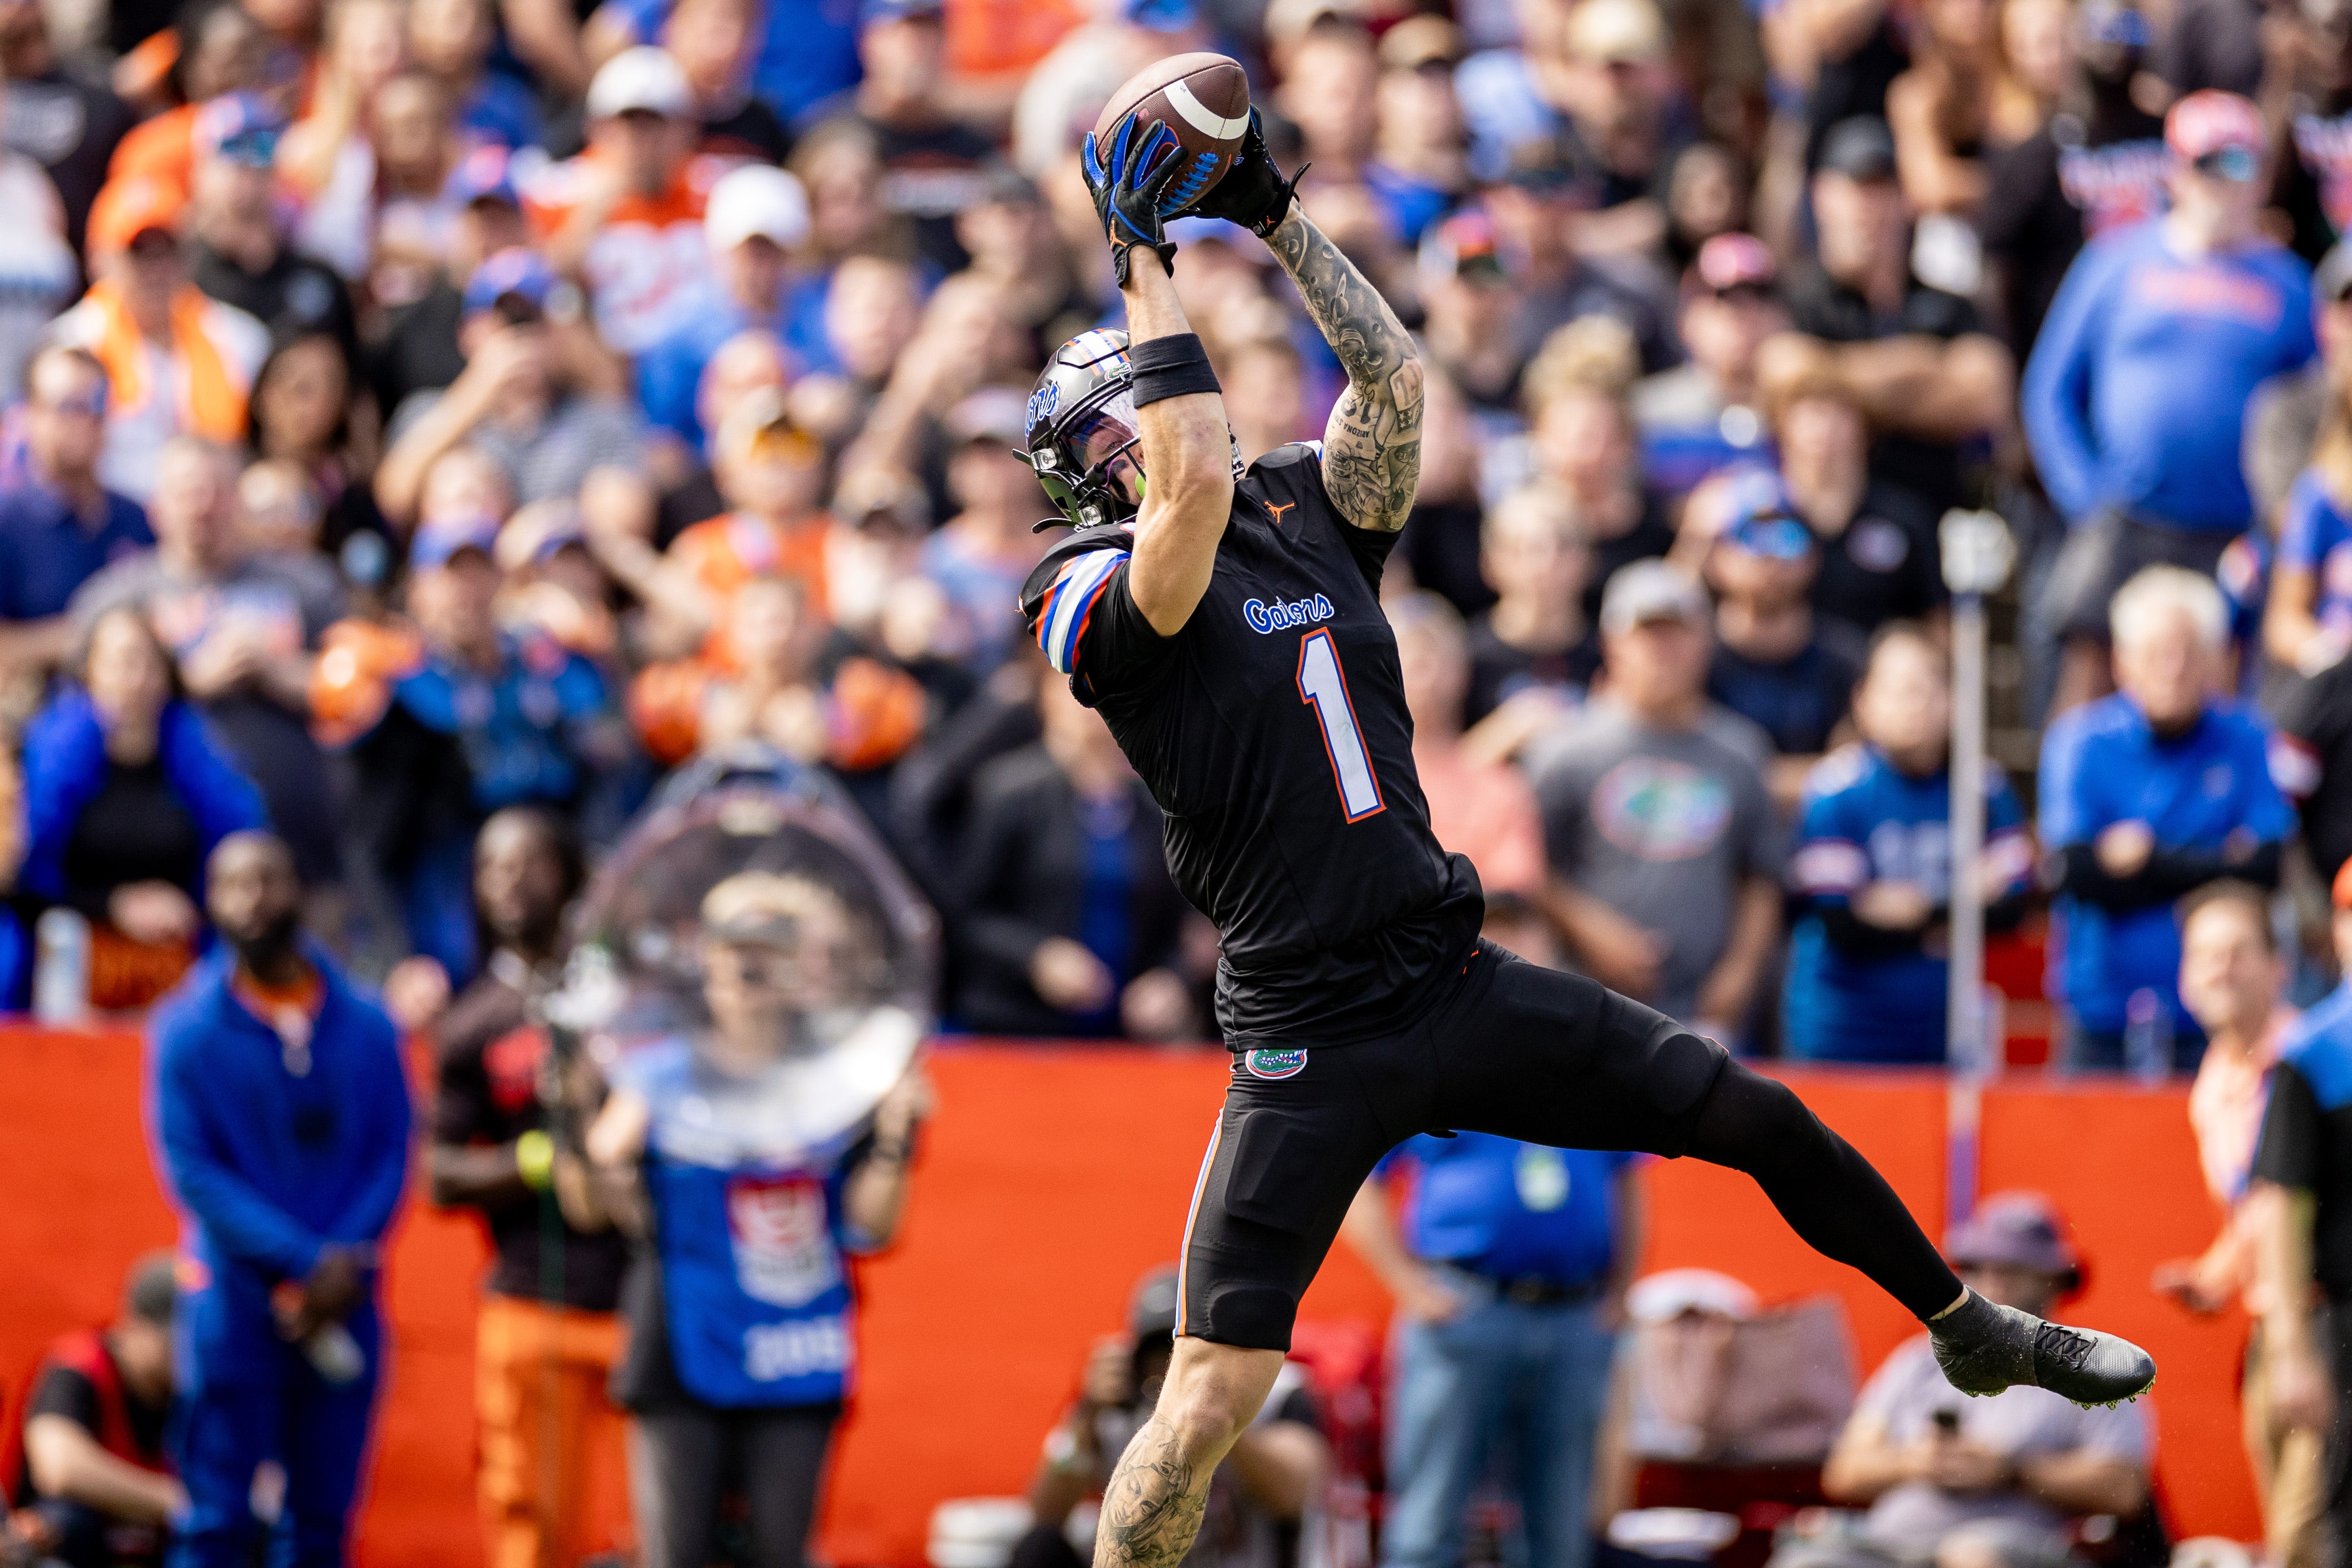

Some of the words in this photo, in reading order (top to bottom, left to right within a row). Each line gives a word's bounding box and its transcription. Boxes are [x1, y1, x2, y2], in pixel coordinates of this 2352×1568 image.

[1343, 423, 1370, 438] ARIZONA
[1243, 594, 1334, 634] Gators
[1296, 626, 1387, 824] 1
